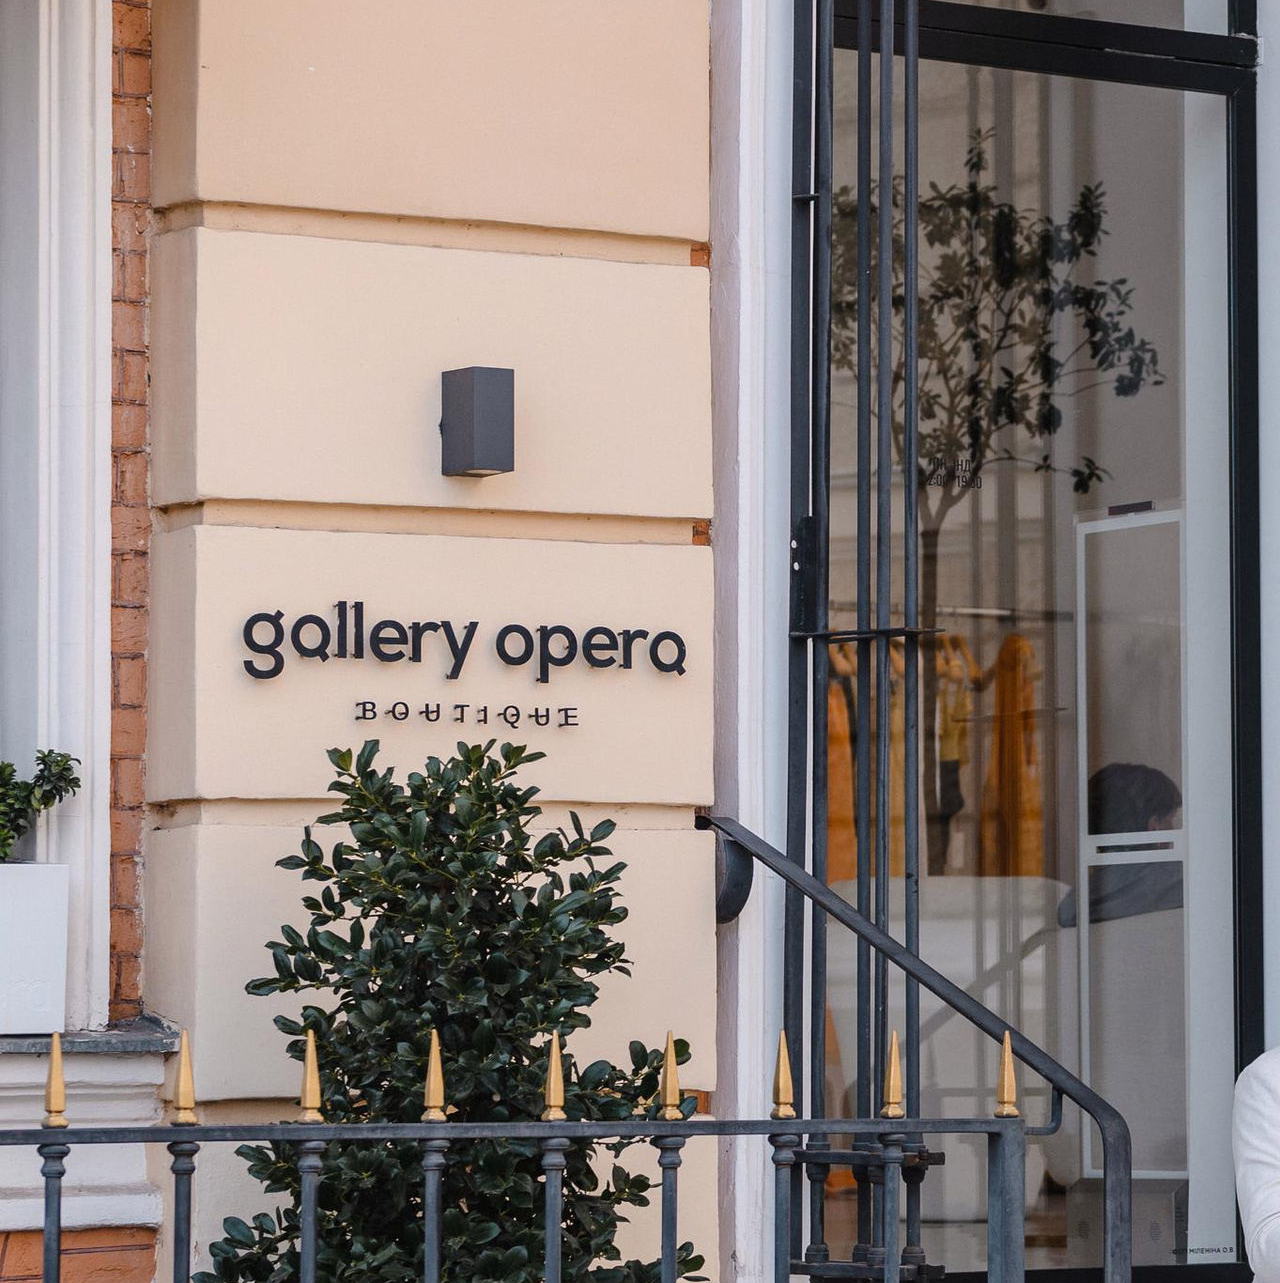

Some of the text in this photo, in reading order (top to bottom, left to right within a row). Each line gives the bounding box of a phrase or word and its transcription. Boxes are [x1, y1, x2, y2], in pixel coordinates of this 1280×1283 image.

[243, 601, 687, 684] gallery opera
[356, 701, 579, 727] BOUTIQUE
